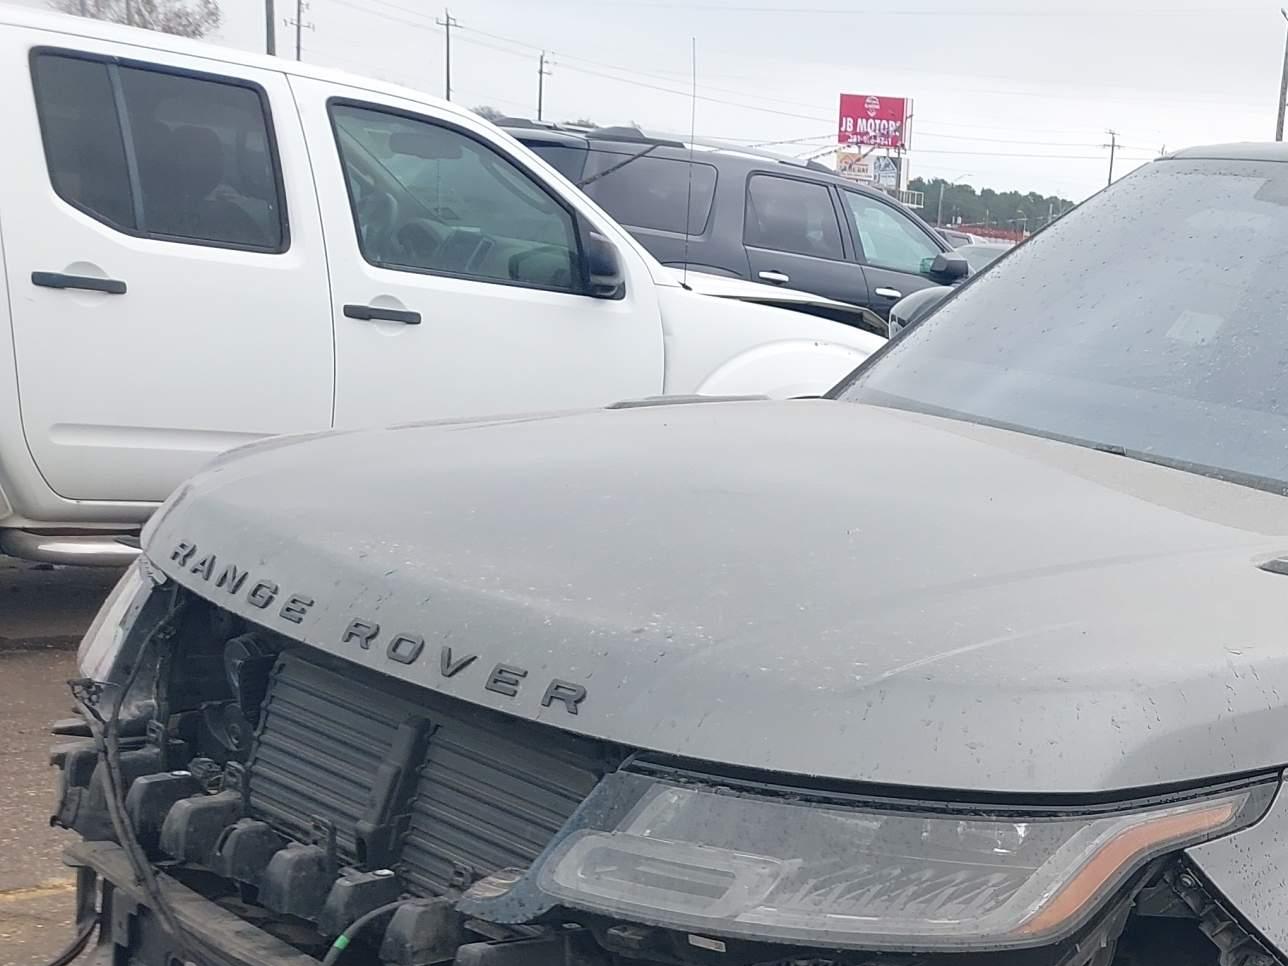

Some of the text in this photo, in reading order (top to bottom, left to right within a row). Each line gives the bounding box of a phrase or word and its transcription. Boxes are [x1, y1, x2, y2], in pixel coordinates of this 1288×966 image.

[840, 117, 854, 132] JB
[169, 539, 588, 715] RANGE ROVER
